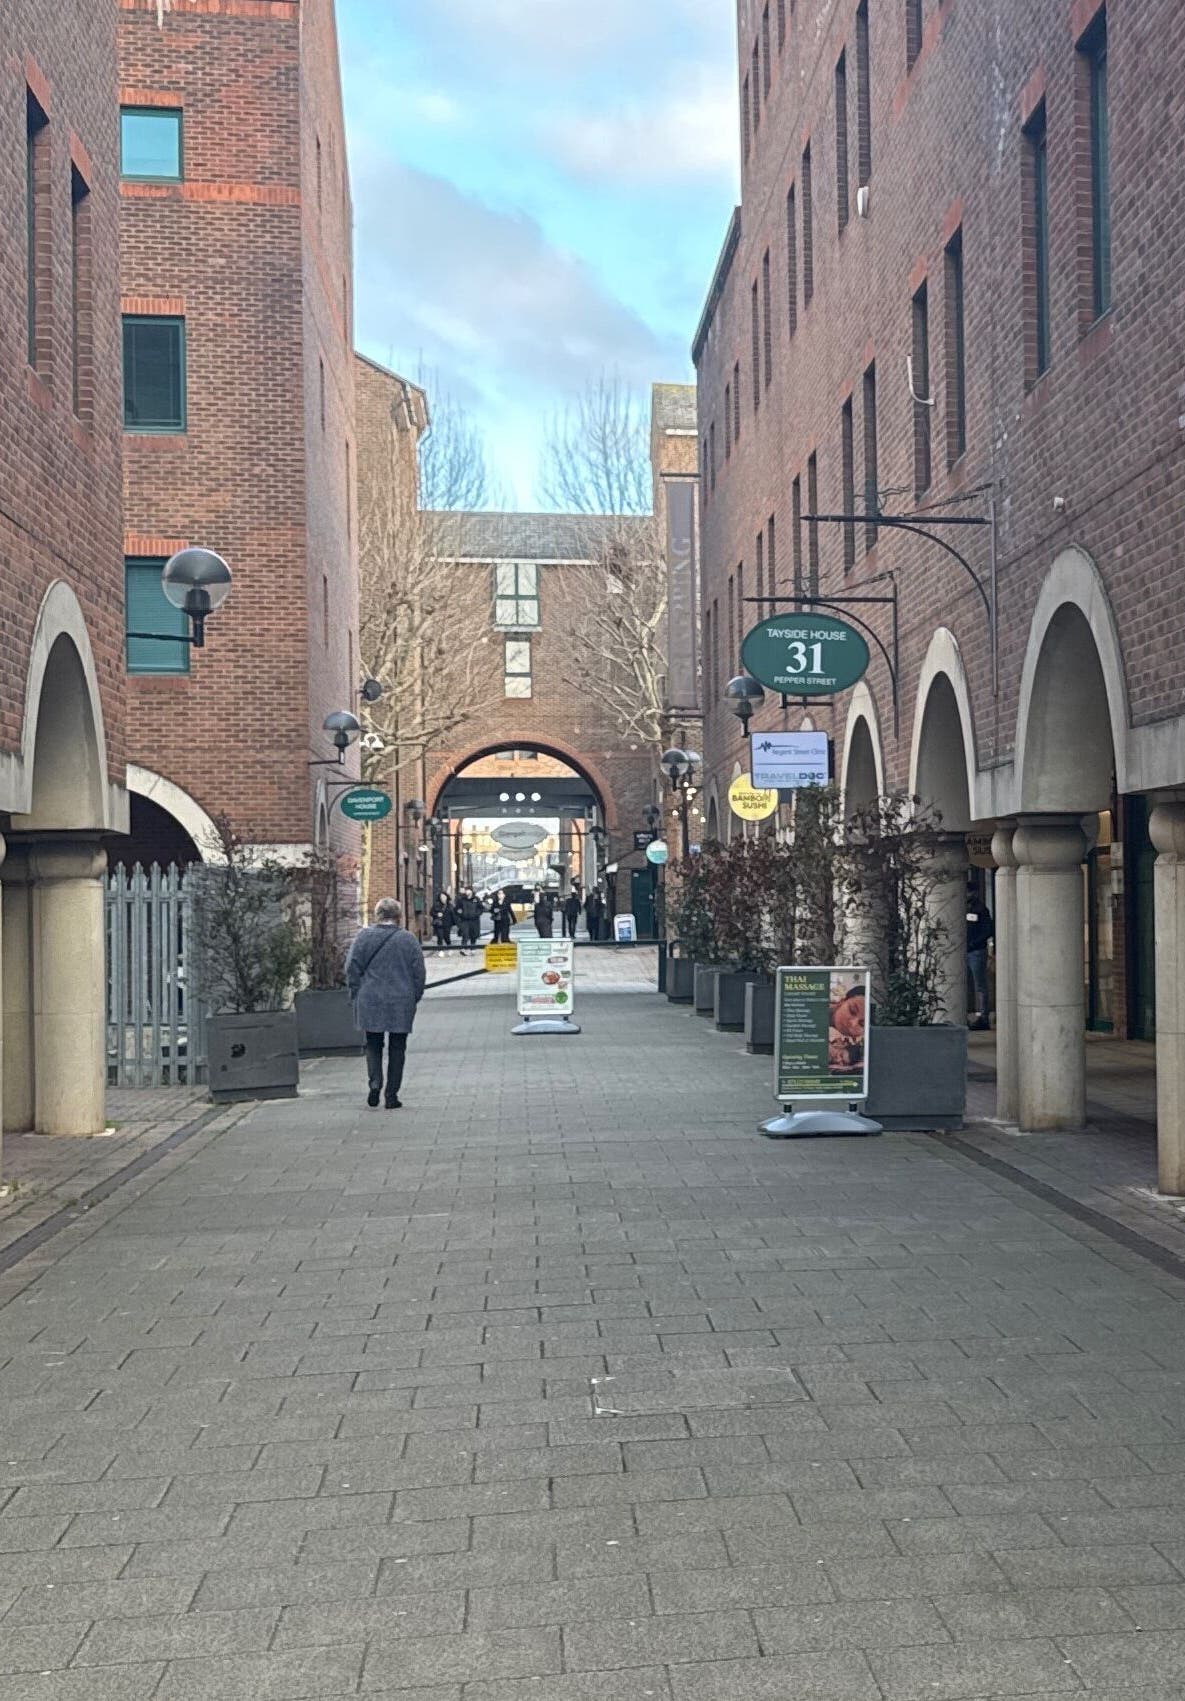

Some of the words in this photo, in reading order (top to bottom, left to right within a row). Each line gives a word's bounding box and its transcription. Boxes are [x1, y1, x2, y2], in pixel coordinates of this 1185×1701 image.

[766, 628, 808, 639] TAYSIDE
[810, 630, 847, 640] HOUSE
[786, 641, 825, 674] 31
[774, 676, 805, 684] PEPPER
[807, 677, 837, 685] STREET
[784, 975, 807, 983] THAI
[784, 983, 825, 991] MASSAGE
